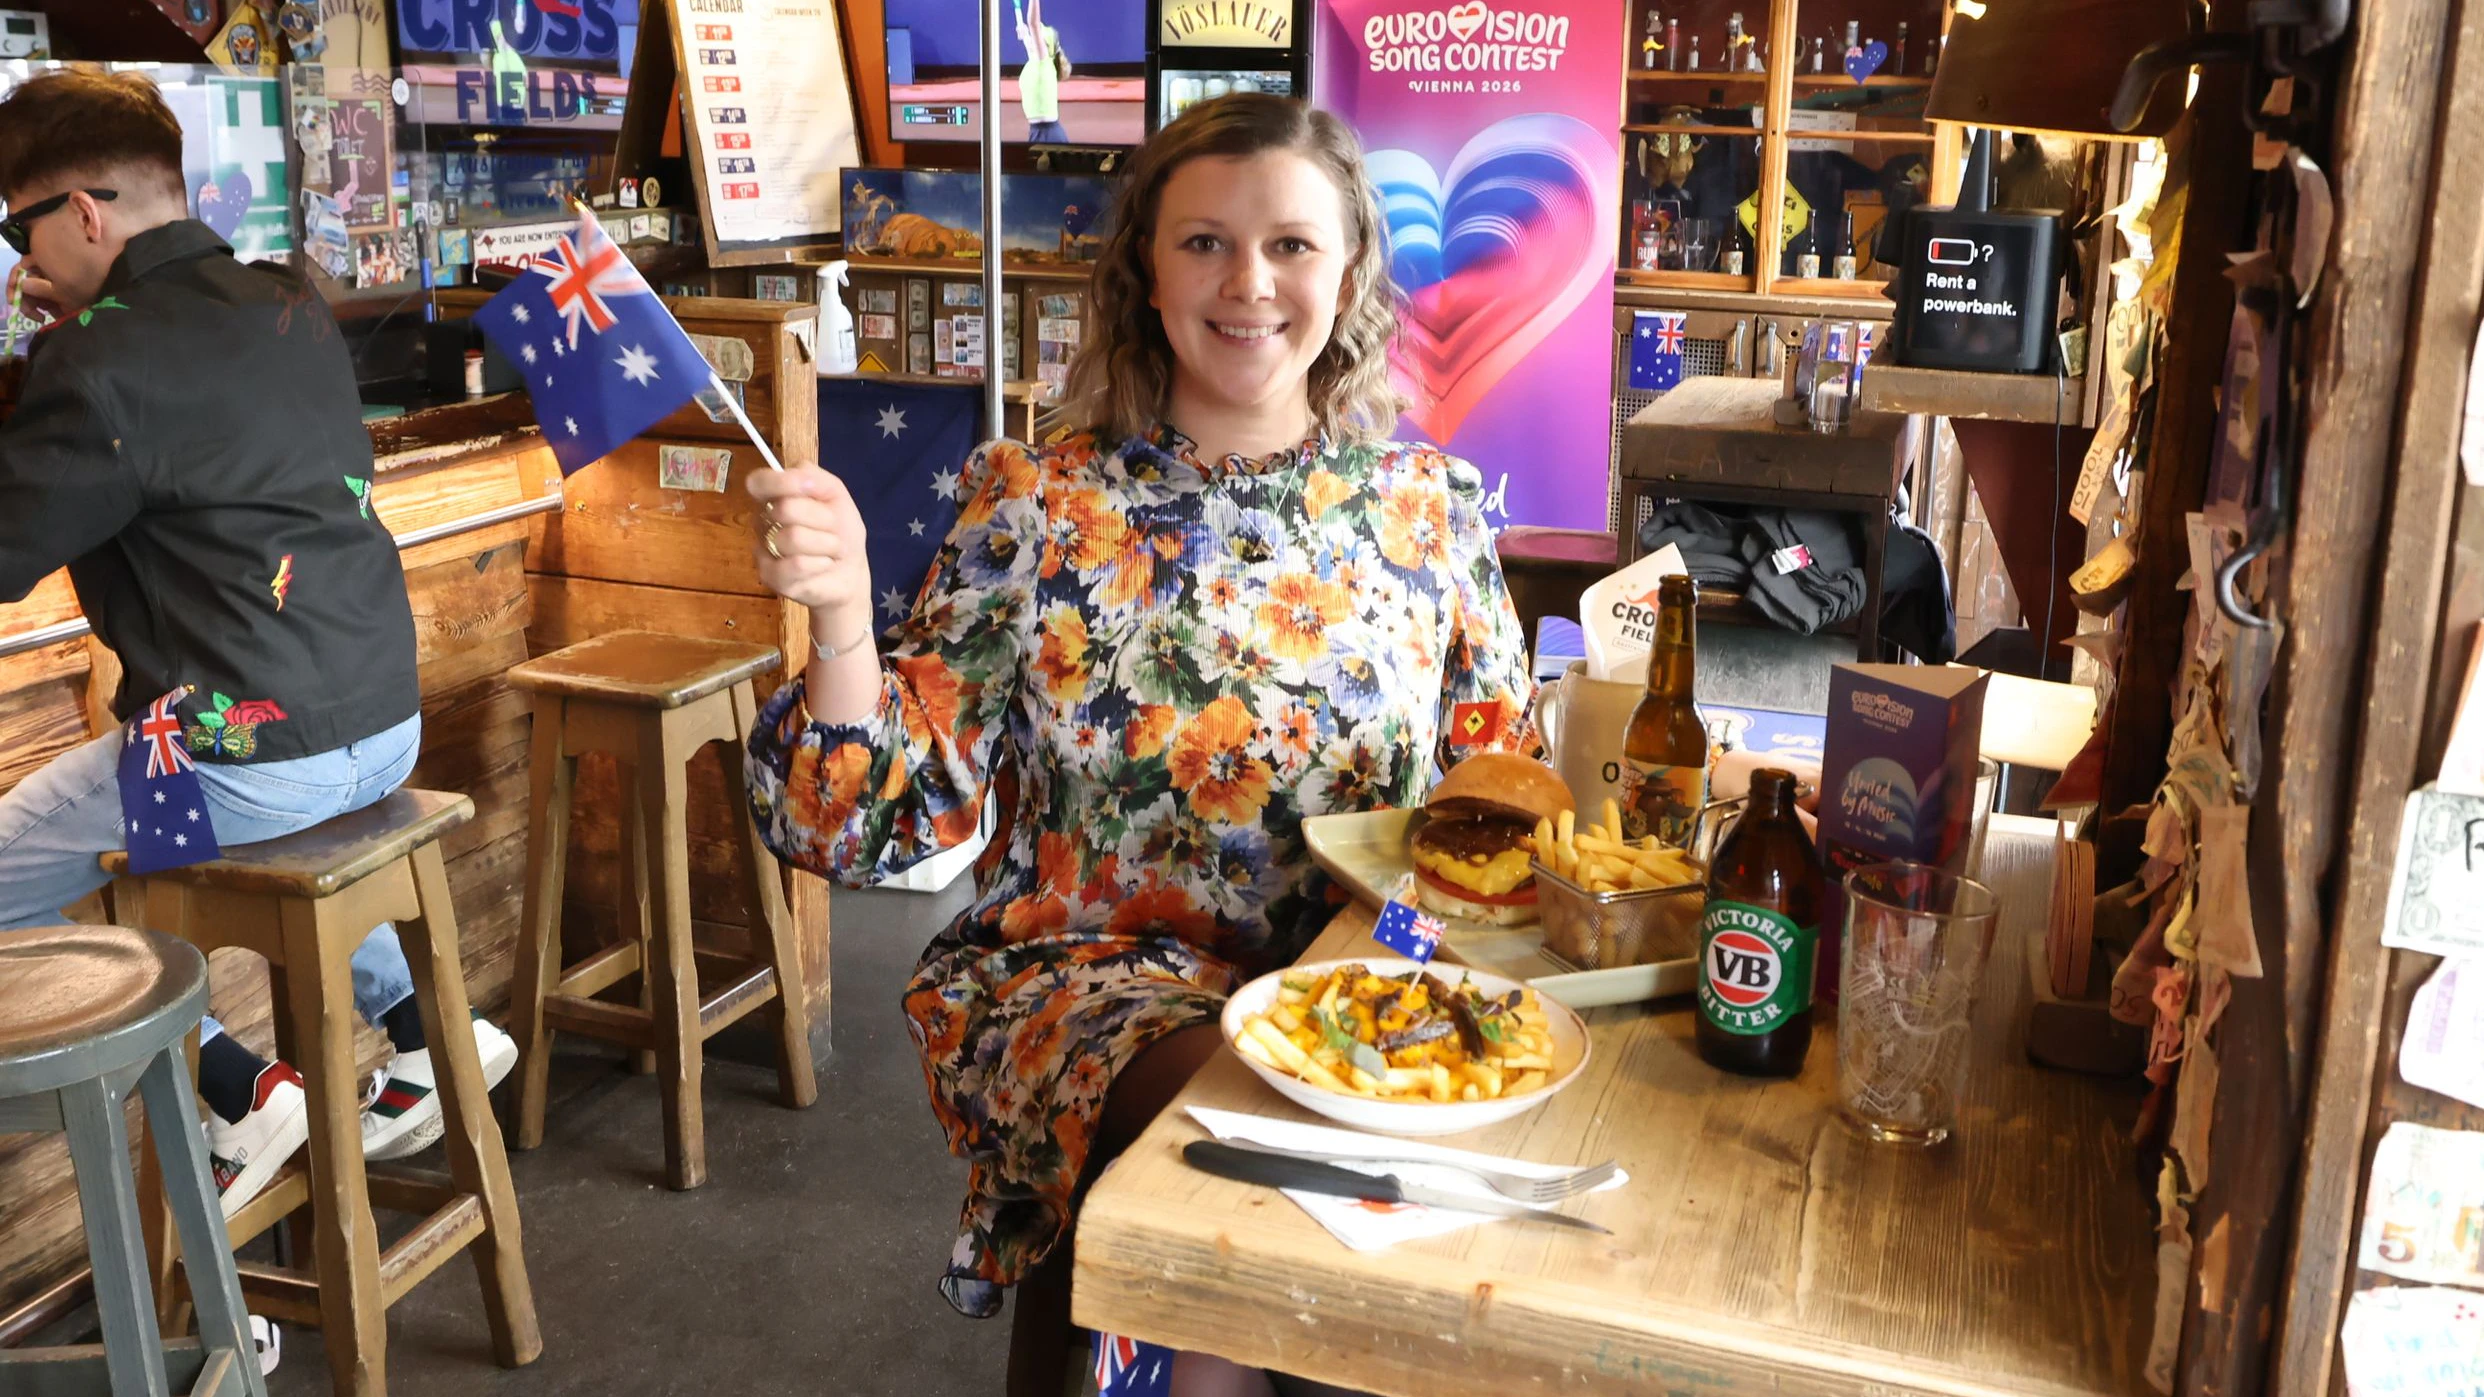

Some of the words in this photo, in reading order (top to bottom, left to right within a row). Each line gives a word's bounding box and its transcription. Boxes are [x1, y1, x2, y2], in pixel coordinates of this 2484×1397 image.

[402, 0, 619, 56] CROSS
[1165, 1, 1287, 42] VÖSLAUER
[1369, 44, 1441, 72] SONG
[1444, 43, 1564, 72] CONTEST
[456, 70, 600, 124] FIELDS
[1409, 80, 1475, 93] VIENNA
[1481, 80, 1521, 93] 2026
[330, 106, 368, 136] WC
[499, 234, 512, 245] YOU
[513, 233, 526, 244] ARE
[528, 232, 543, 242] NOW
[1637, 247, 1658, 260] RUM
[1926, 272, 1963, 289] Rent
[1966, 278, 1977, 290] a
[1923, 298, 2017, 316] powerbank.
[1611, 601, 1656, 627] CRO
[1620, 624, 1652, 643] FIEL
[1848, 770, 1893, 803] United
[1840, 788, 1857, 815] by
[1705, 909, 1795, 953] VICTORIA
[1713, 944, 1771, 988] VB
[1702, 985, 1783, 1027] BITTER
[2378, 1224, 2416, 1264] 5
